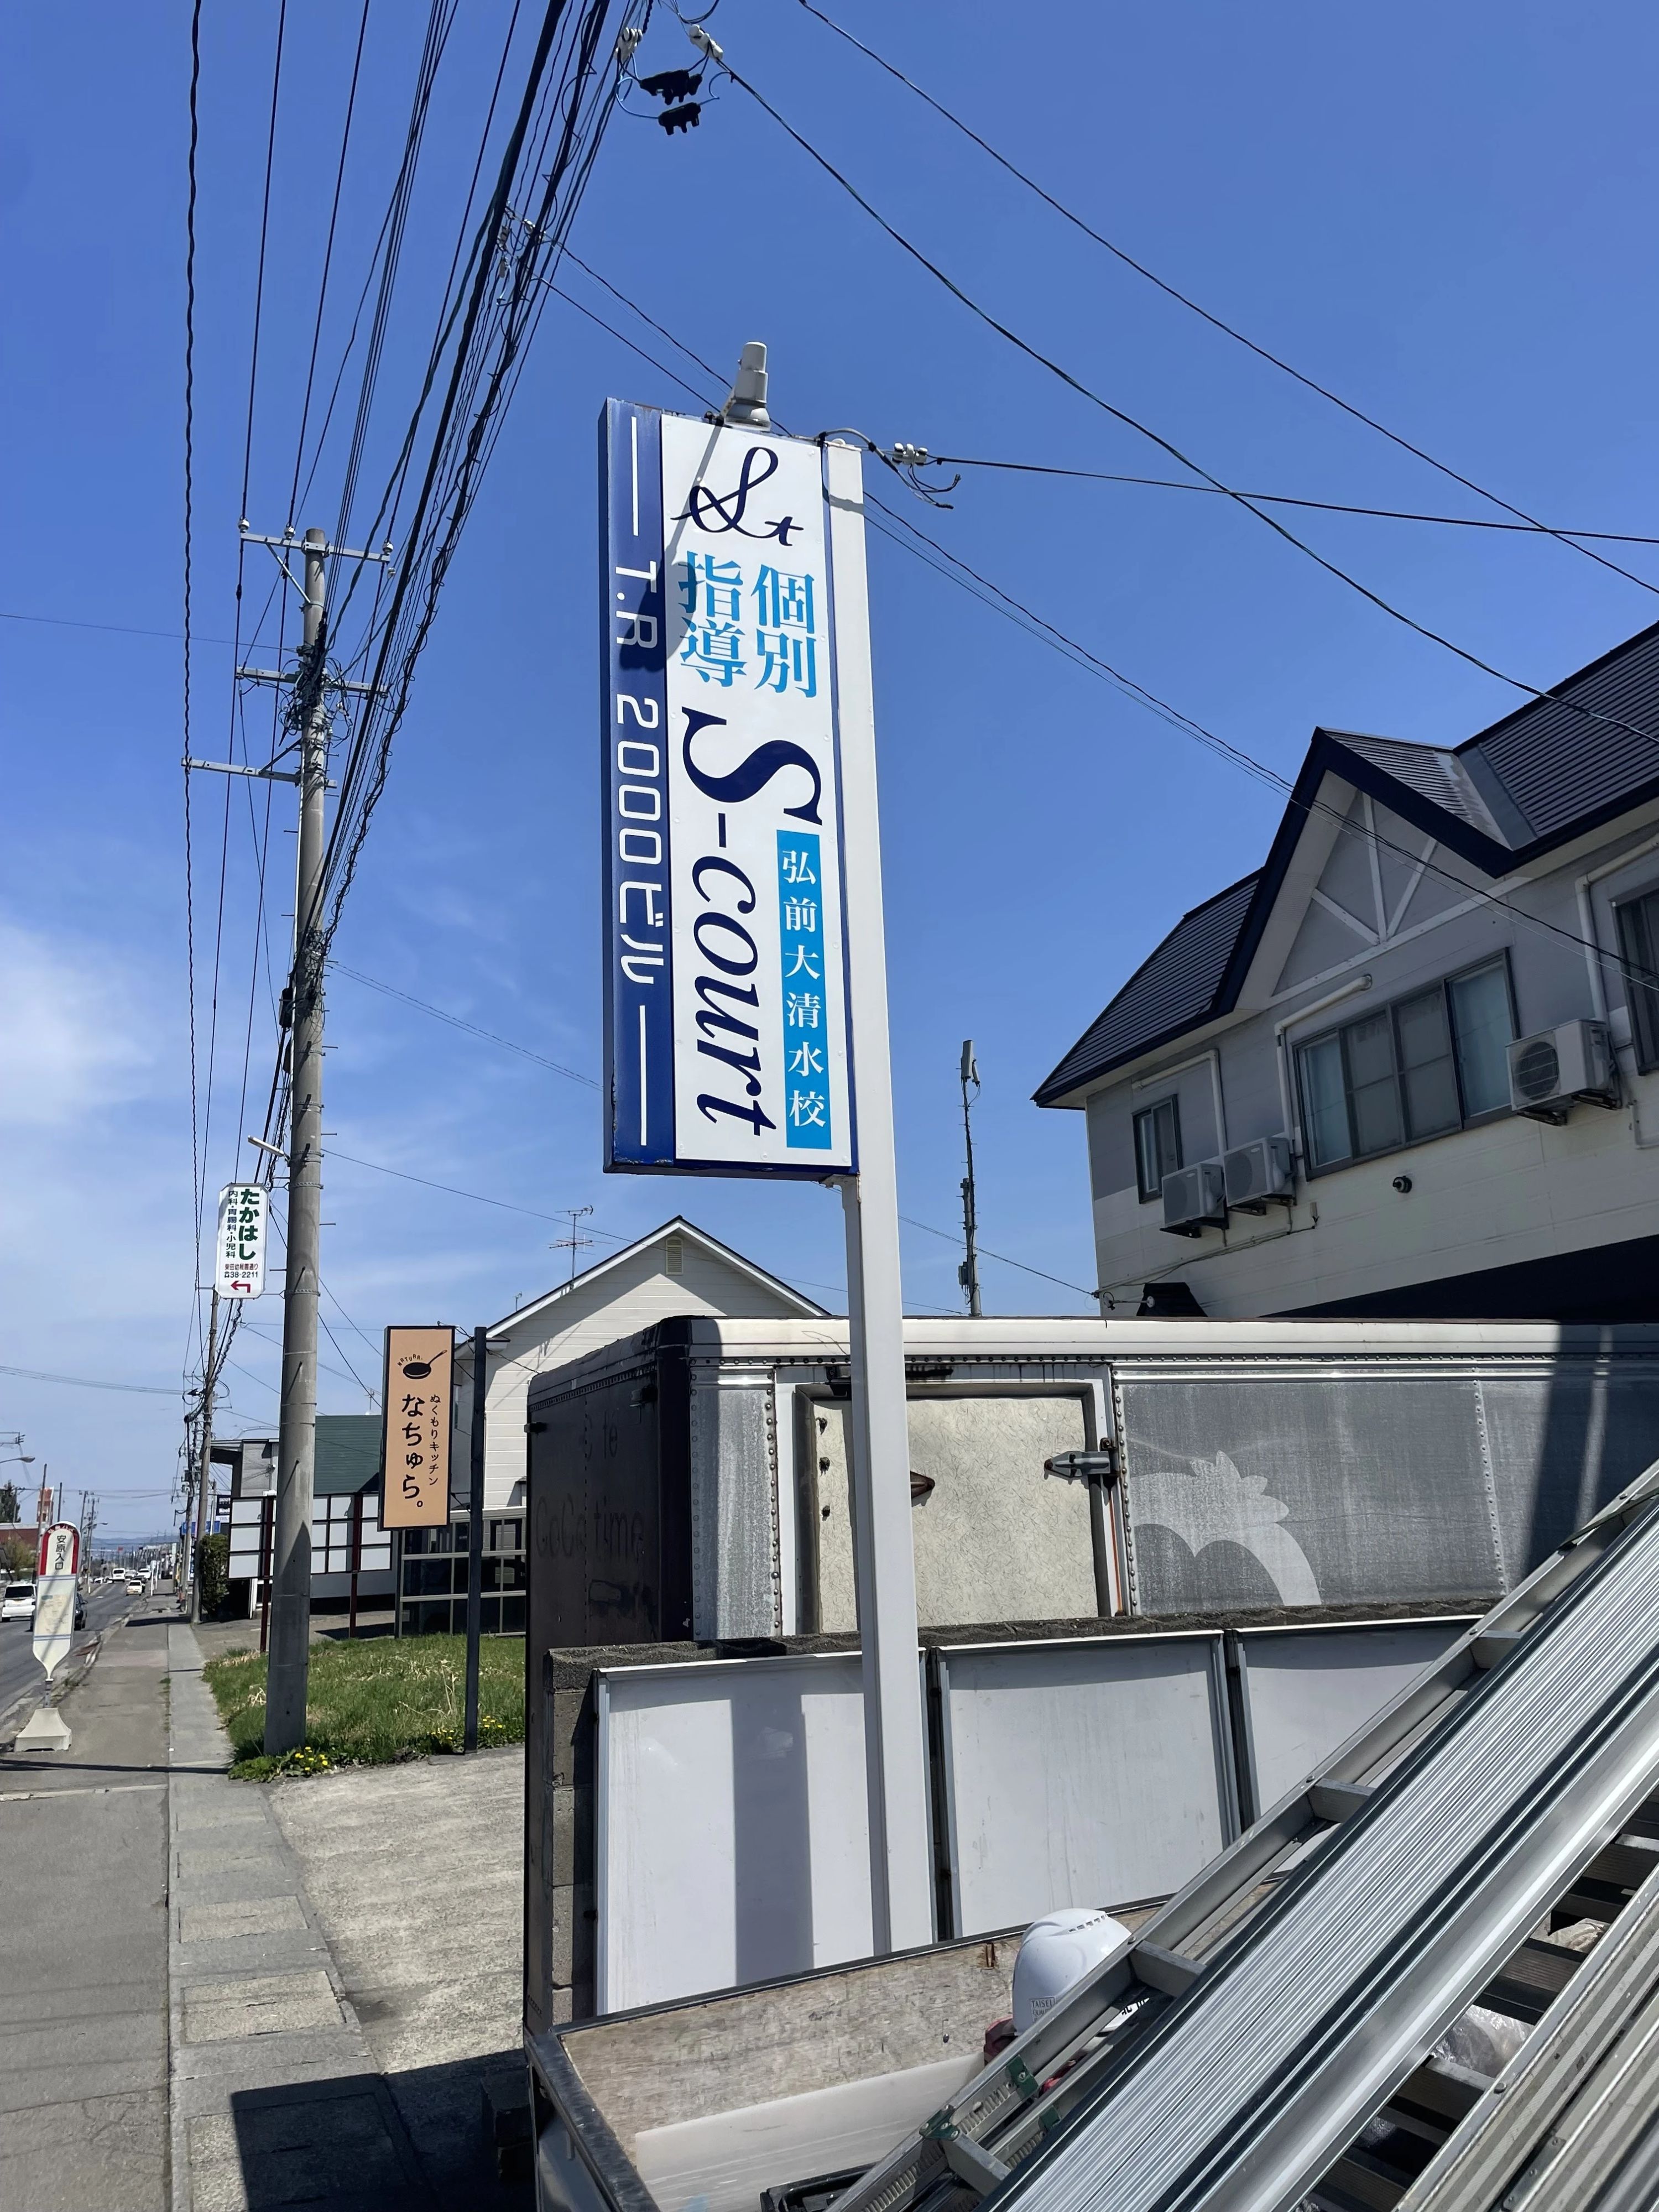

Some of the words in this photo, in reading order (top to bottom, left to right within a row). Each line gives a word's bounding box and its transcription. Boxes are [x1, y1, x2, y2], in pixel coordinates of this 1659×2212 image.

[615, 560, 658, 649] T.R
[677, 550, 748, 687] 指導
[750, 564, 817, 698] 個別
[616, 693, 664, 984] 2000ビル
[681, 706, 823, 1136] S-court
[781, 849, 827, 1128] 弘前大清水校
[238, 1188, 260, 1261] たかはし
[401, 1393, 426, 1508] なちゅら。
[428, 1394, 441, 1486] ぬくもりキッチン
[55, 1535, 66, 1570] 安原入口
[1031, 1999, 1053, 2008] TAISEI
